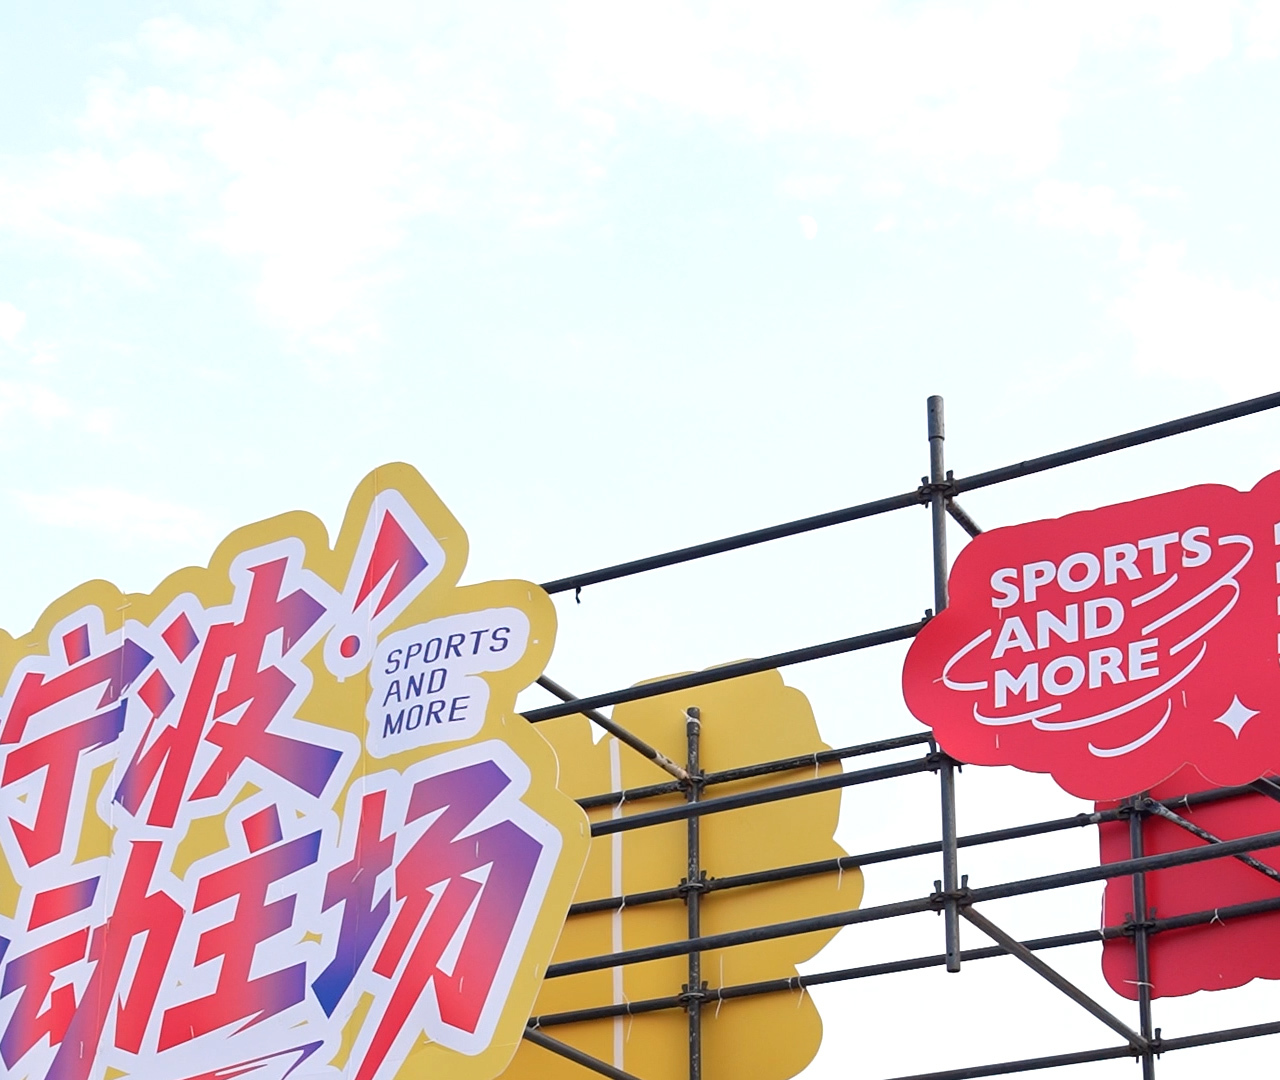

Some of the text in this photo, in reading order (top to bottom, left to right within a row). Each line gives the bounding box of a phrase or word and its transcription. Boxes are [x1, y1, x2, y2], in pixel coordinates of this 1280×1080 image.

[990, 526, 1212, 609] SPORTS
[384, 626, 511, 675] SPORTS
[991, 596, 1125, 659] AND
[382, 667, 448, 707] AND
[994, 638, 1160, 708] MORE
[382, 695, 471, 739] MORE
